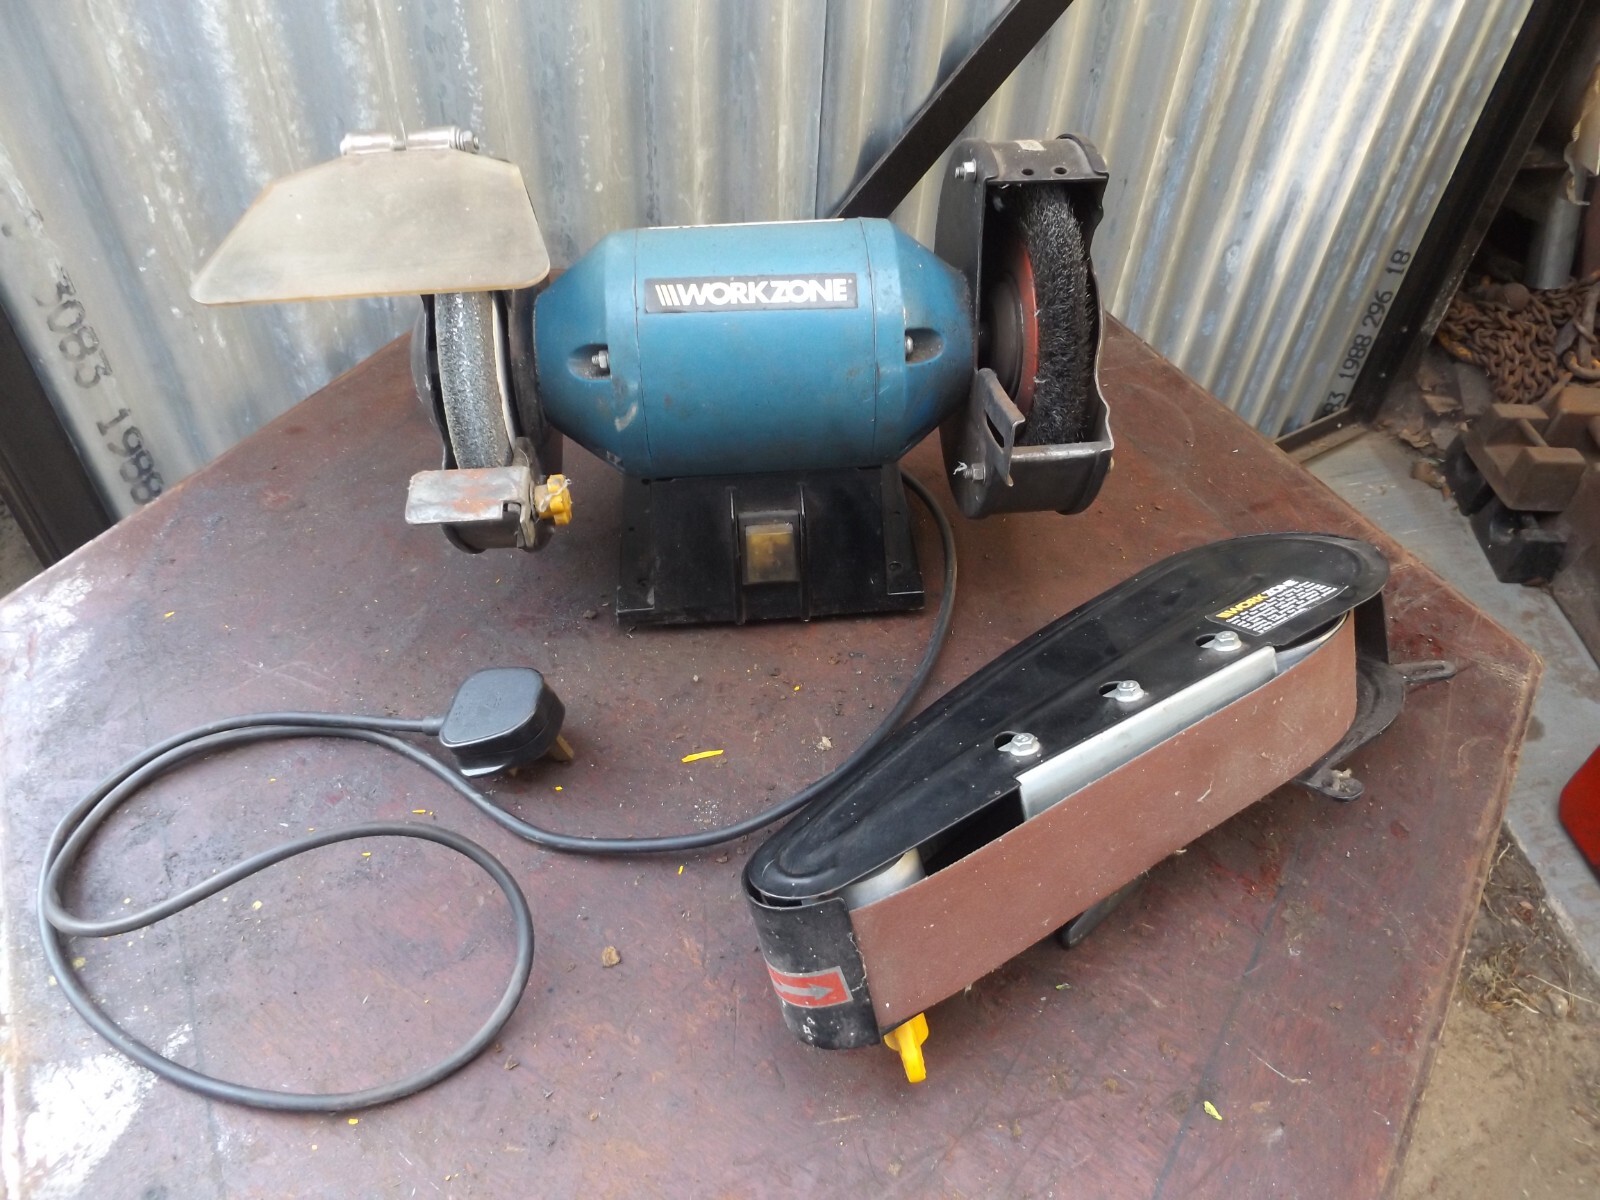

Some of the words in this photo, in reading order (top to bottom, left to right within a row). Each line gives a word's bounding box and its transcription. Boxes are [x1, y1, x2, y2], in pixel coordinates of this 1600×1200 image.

[1338, 334, 1372, 380] 1988
[1362, 290, 1394, 329] 296
[1385, 250, 1412, 276] 18
[96, 407, 164, 506] 1988
